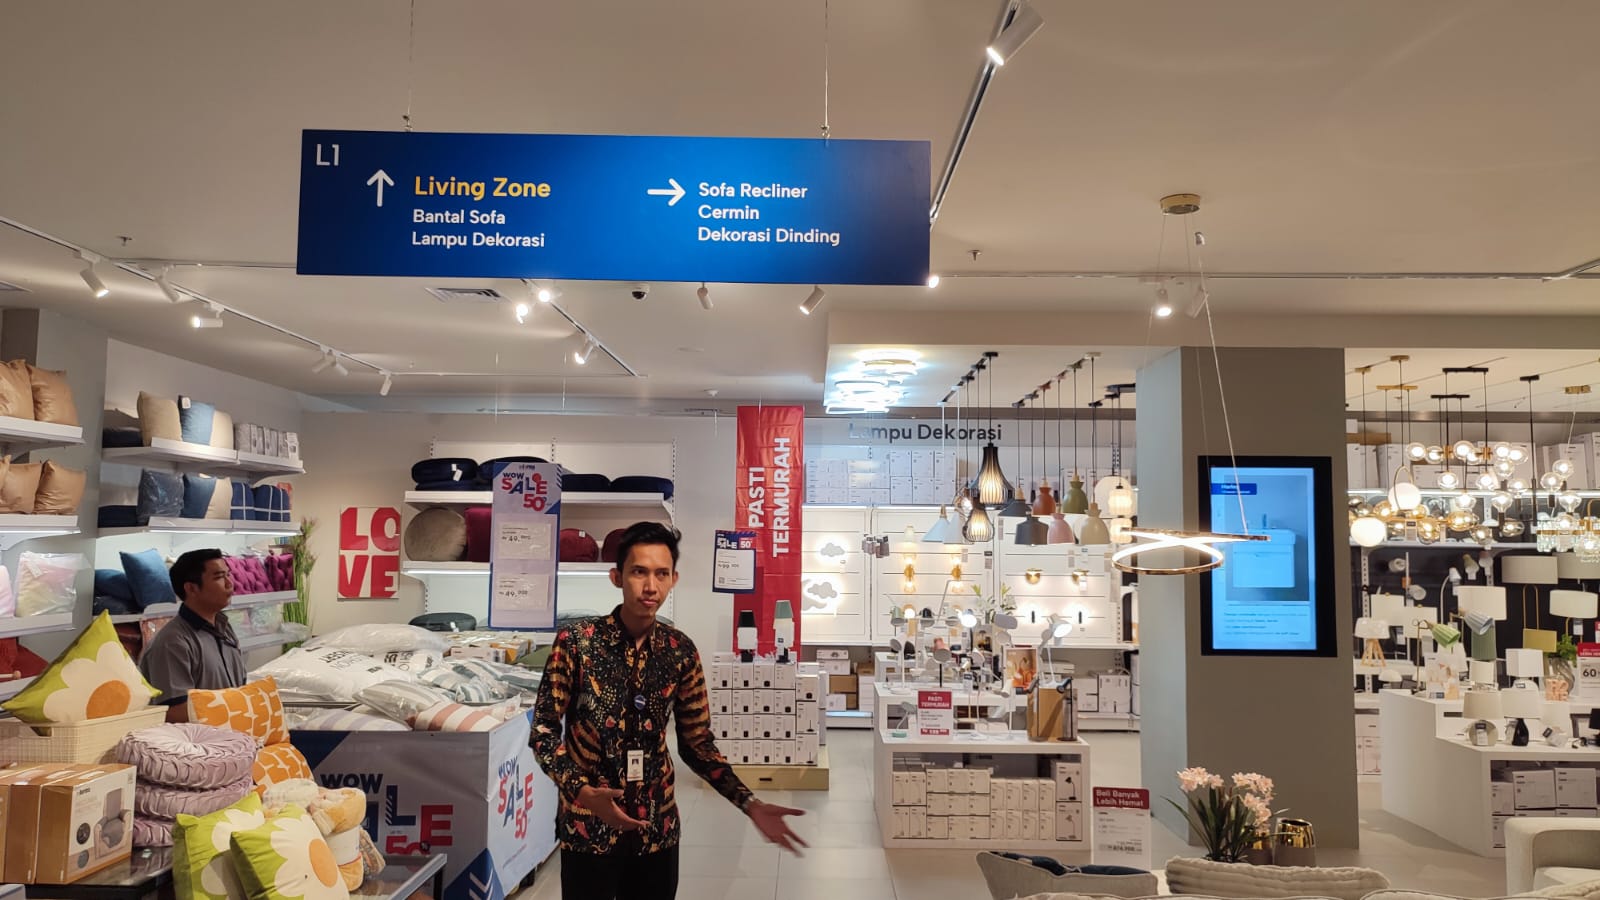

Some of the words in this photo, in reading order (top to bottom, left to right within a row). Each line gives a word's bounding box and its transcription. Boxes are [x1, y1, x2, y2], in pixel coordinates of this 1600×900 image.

[316, 143, 340, 167] L1
[414, 175, 485, 201] Living
[492, 177, 551, 198] Zone
[698, 182, 735, 198] Sofa
[740, 183, 808, 199] Recliner
[412, 208, 465, 224] Bantal
[469, 210, 506, 225] Sofa
[697, 204, 760, 220] Cermin
[411, 231, 468, 250] Lampu
[472, 231, 545, 248] Dekorasi
[697, 226, 771, 243] Dekorasi
[775, 227, 841, 247] Dinding
[848, 422, 912, 444] Lampu
[917, 423, 1002, 441] Dekorasi
[501, 475, 548, 495] SALE
[502, 472, 525, 480] WOW
[748, 466, 766, 528] PASTI
[773, 437, 791, 558] TERMURAH
[498, 755, 519, 779] WOW
[319, 773, 384, 795] WOW
[1095, 789, 1111, 797] Beli
[1112, 790, 1140, 799] Banyak
[497, 763, 534, 828] SALE
[1096, 798, 1118, 806] Lebih
[1118, 799, 1144, 807] Hemat
